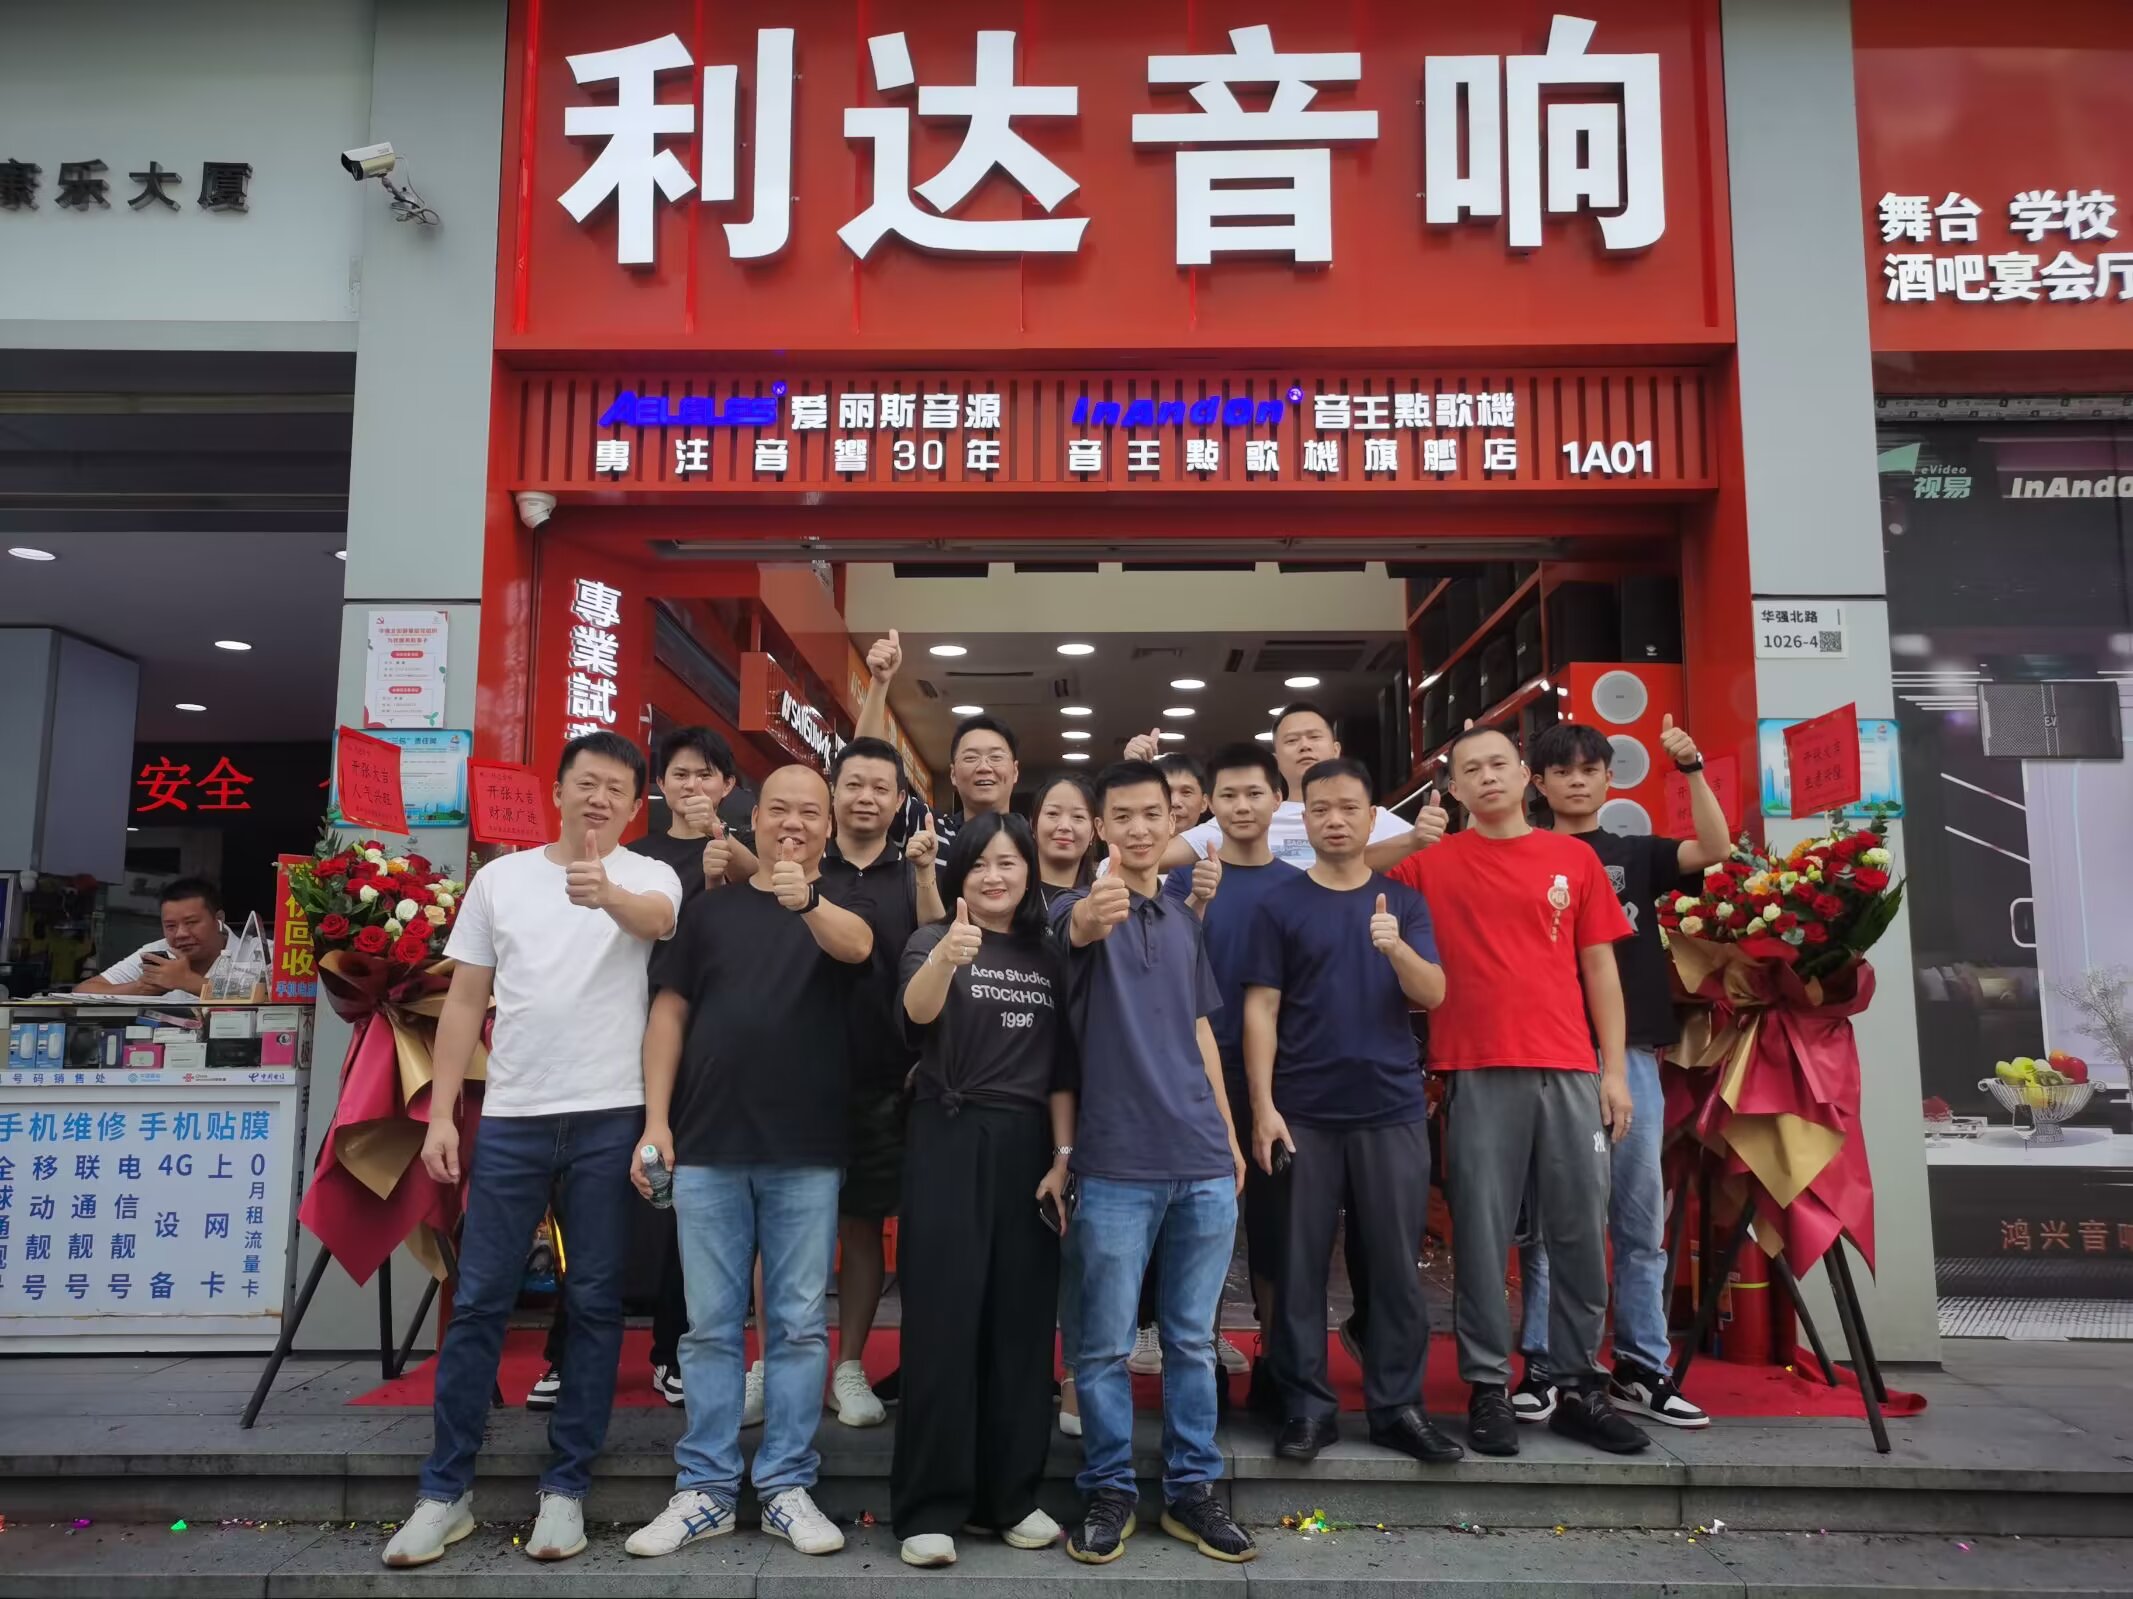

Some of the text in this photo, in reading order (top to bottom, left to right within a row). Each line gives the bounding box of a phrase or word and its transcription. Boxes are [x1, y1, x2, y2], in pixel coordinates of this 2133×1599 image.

[557, 13, 1666, 265] 利达音响
[1878, 188, 2120, 243] 舞台 学校
[1884, 250, 2133, 302] 酒吧宴会厅
[791, 392, 1001, 430] 爱丽斯音源
[1071, 395, 1285, 427] InAndOn
[1313, 391, 1516, 430] 音王點歌機
[1561, 440, 1655, 474] 1A01
[1921, 465, 1967, 475] eVideo
[1913, 476, 1973, 499] 视易
[1761, 610, 1818, 623] 华强北路
[1764, 635, 1818, 648] 1026-4
[136, 756, 255, 812] 安全
[487, 785, 534, 804] 开张大吉
[971, 964, 1004, 981] Acne
[1000, 1012, 1034, 1028] 1996
[0, 1111, 270, 1142] 手机维修 手机贴膜
